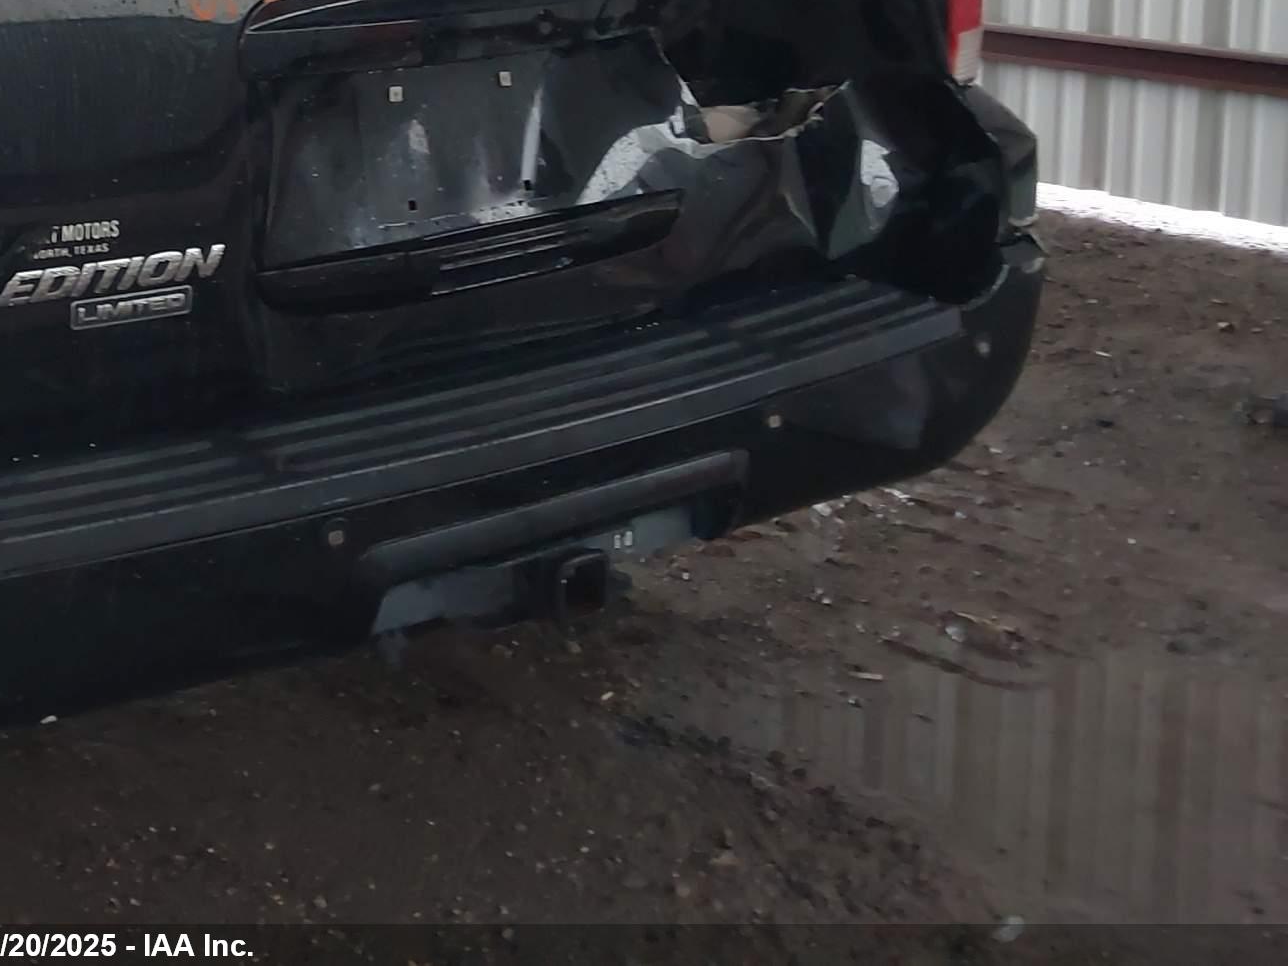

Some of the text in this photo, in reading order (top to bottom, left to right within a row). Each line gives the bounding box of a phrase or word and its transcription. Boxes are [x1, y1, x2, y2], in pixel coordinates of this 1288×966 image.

[60, 219, 121, 243] MOTORS
[73, 242, 111, 255] TEXAS
[76, 292, 187, 325] LIMITED
